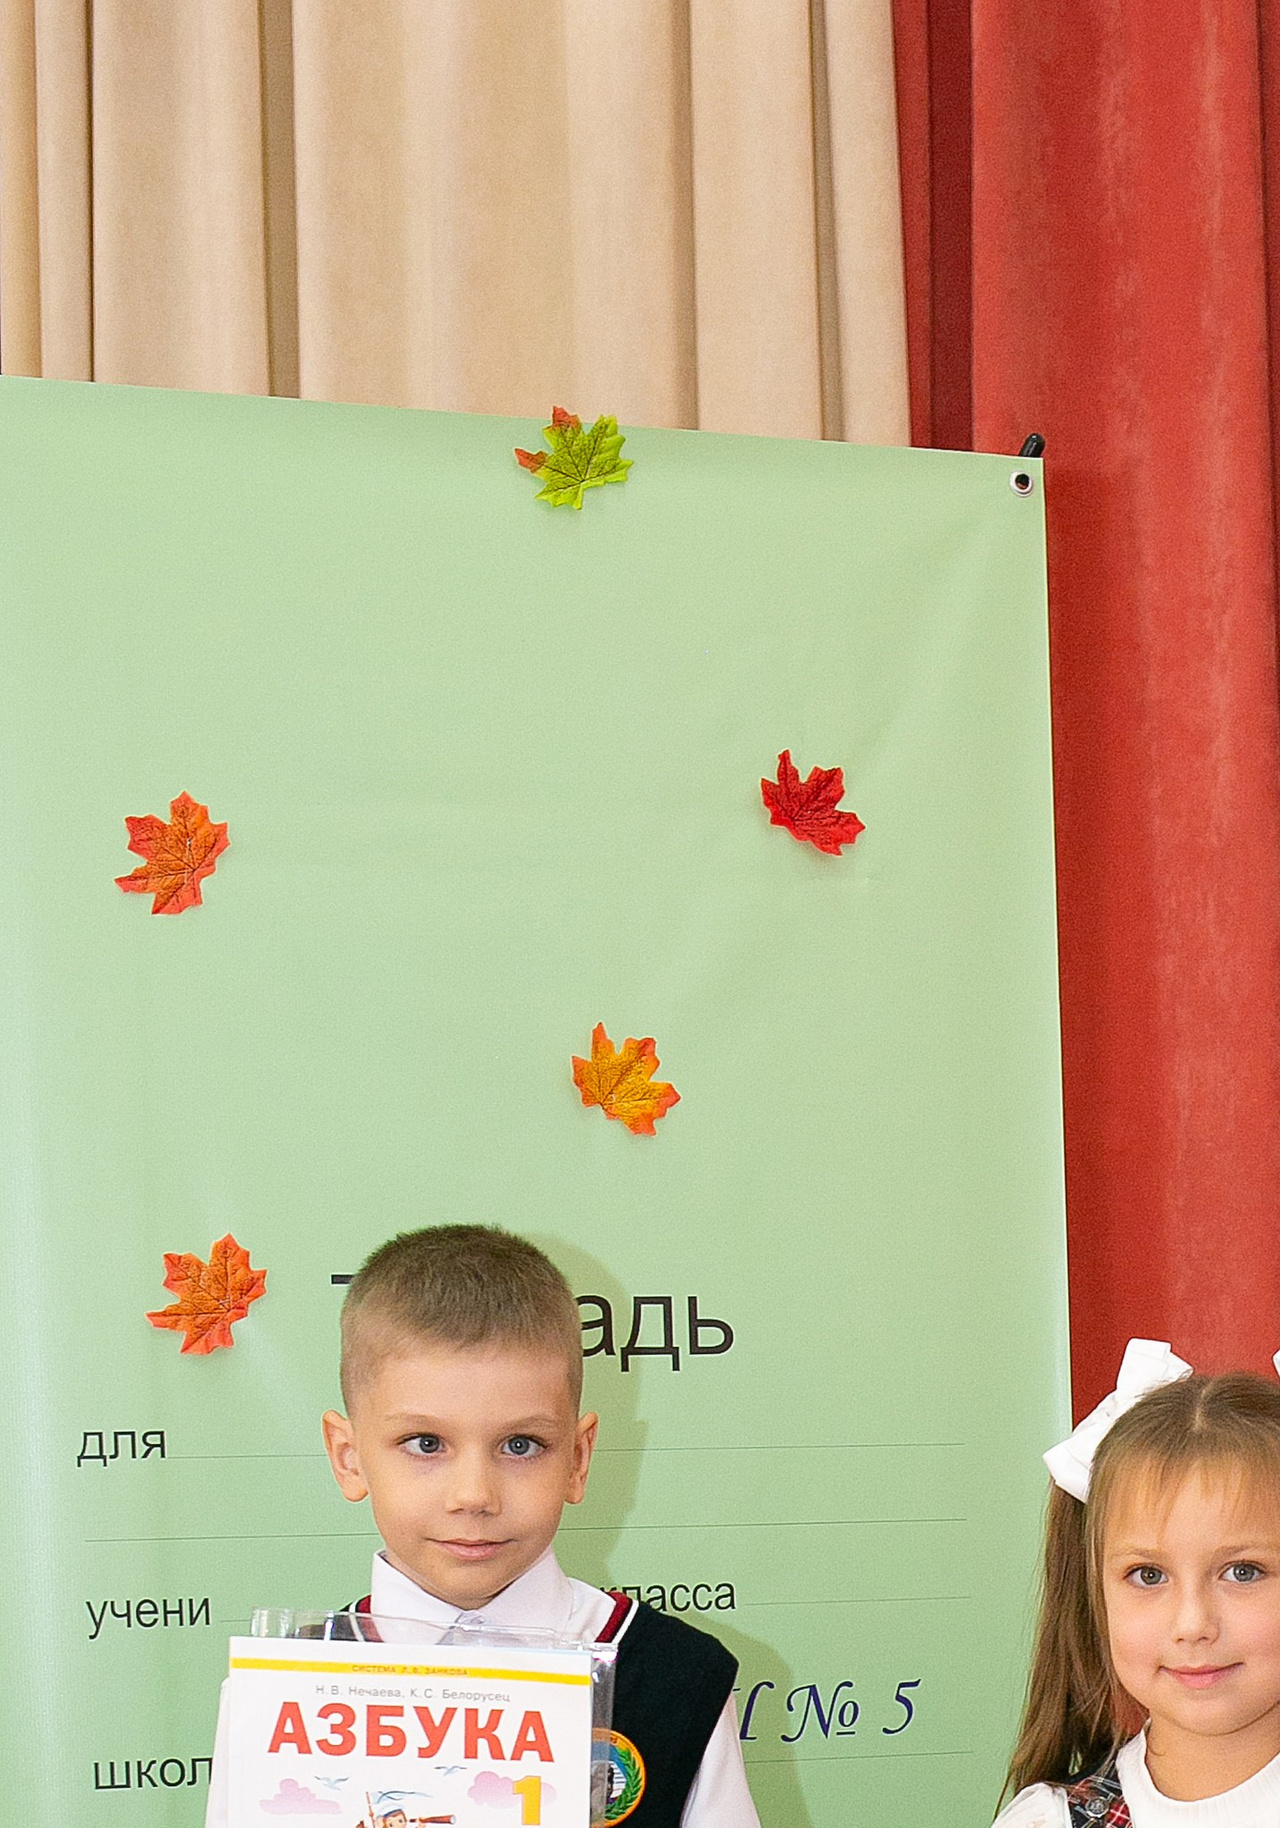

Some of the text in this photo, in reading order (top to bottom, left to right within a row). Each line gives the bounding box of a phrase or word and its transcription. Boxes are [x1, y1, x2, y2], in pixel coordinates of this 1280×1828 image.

[77, 1431, 167, 1467] для
[85, 1597, 212, 1639] учени
[442, 1689, 511, 1702] Белорусец
[882, 1679, 921, 1734] 5
[267, 1701, 555, 1763] АЗБУКА
[512, 1775, 542, 1826] 1
